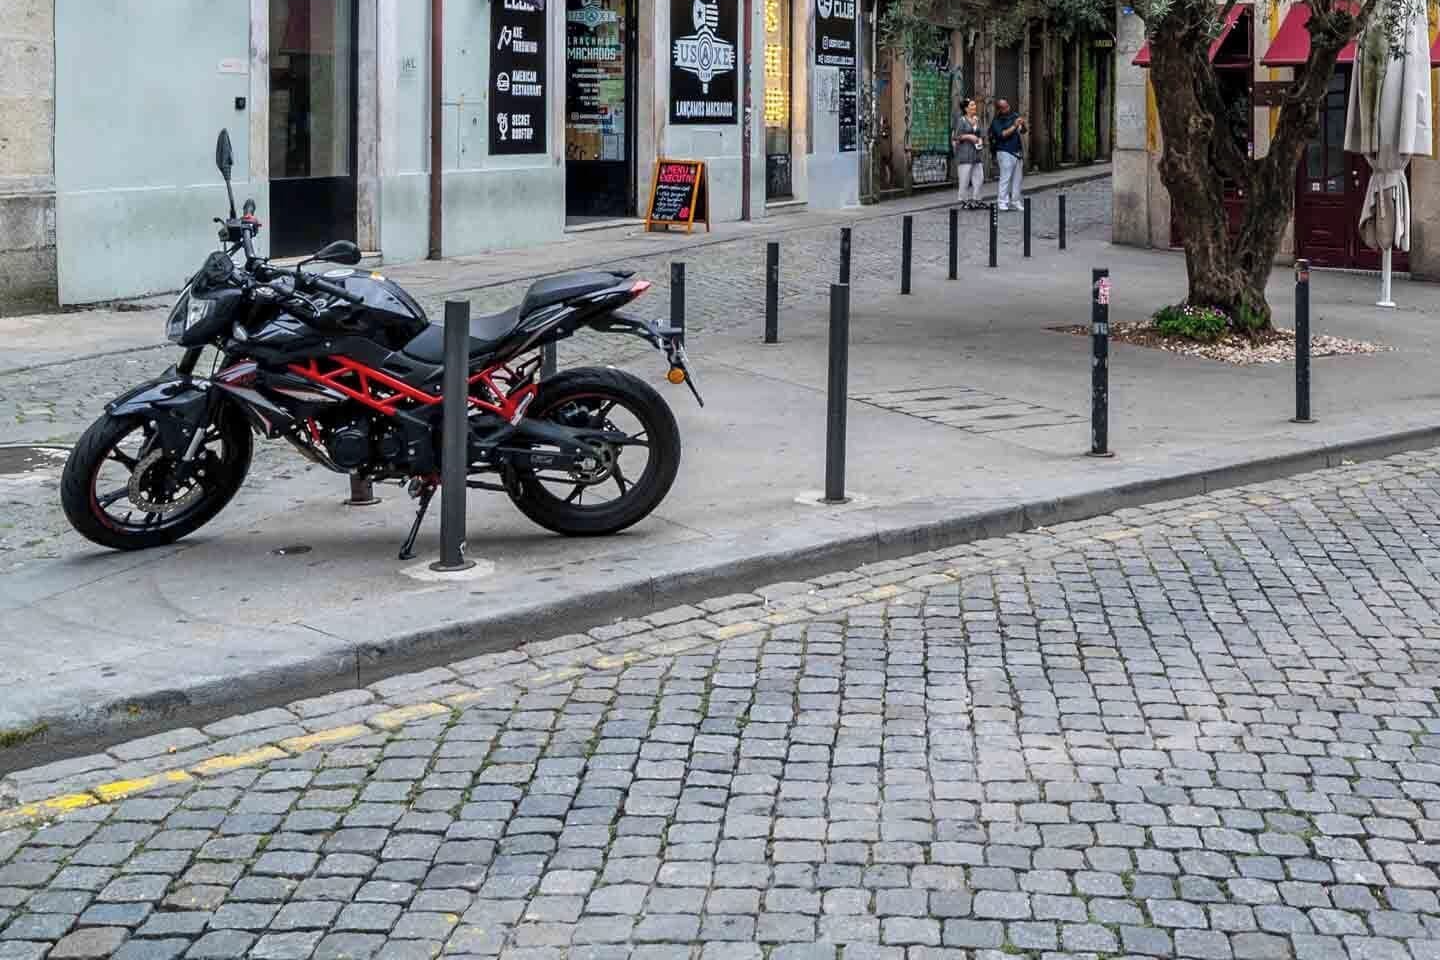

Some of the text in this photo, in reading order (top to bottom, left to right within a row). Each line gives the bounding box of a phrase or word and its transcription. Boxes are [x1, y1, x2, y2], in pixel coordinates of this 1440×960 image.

[833, 3, 855, 20] CLUB
[680, 43, 730, 65] USAXE
[512, 70, 537, 83] AMERICAN
[512, 84, 542, 97] RESTAURANT
[511, 114, 531, 127] SECRET
[511, 127, 534, 140] ROOFTOP
[667, 165, 689, 174] MENU
